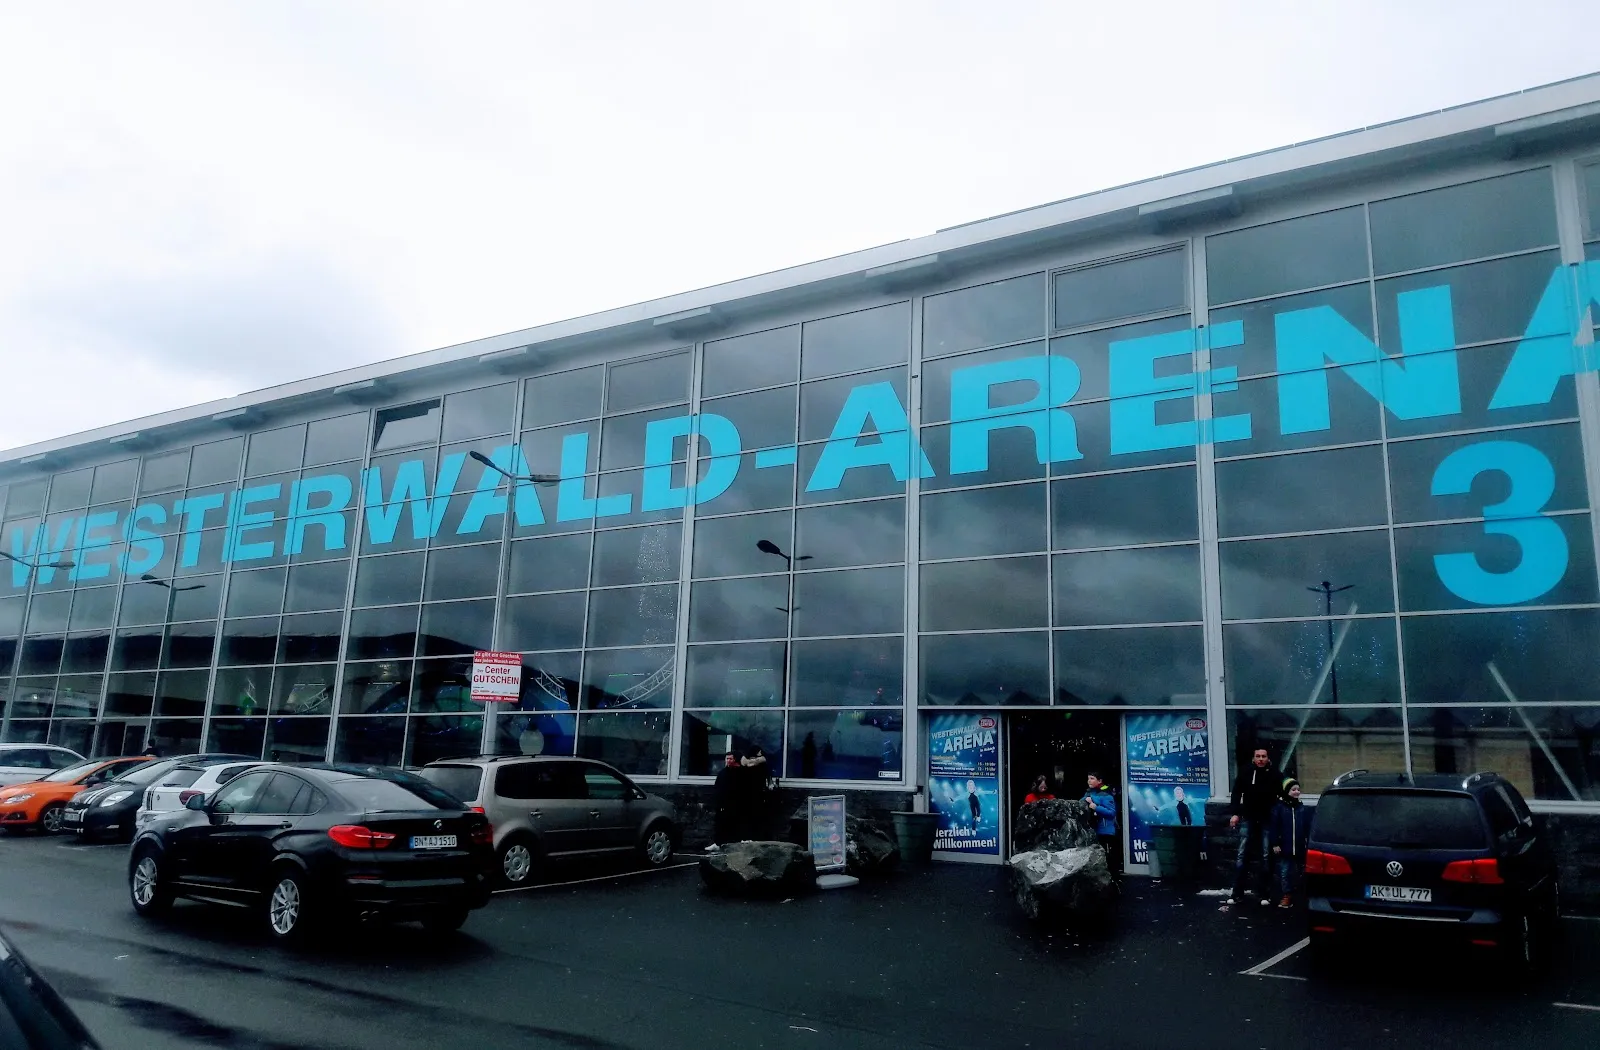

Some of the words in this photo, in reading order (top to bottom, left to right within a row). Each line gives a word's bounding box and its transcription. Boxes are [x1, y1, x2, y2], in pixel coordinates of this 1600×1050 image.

[1430, 440, 1569, 605] 3
[485, 666, 510, 674] Center
[474, 675, 519, 684] GUTSCHEIN
[943, 730, 994, 753] ARENA
[1144, 733, 1205, 758] ARENA
[414, 838, 423, 846] BN
[429, 837, 437, 846] AJ
[439, 836, 456, 846] 1510
[933, 837, 996, 849] Willkommen!
[1372, 887, 1384, 897] AK
[1392, 888, 1406, 898] UL
[1409, 889, 1429, 899] 777
